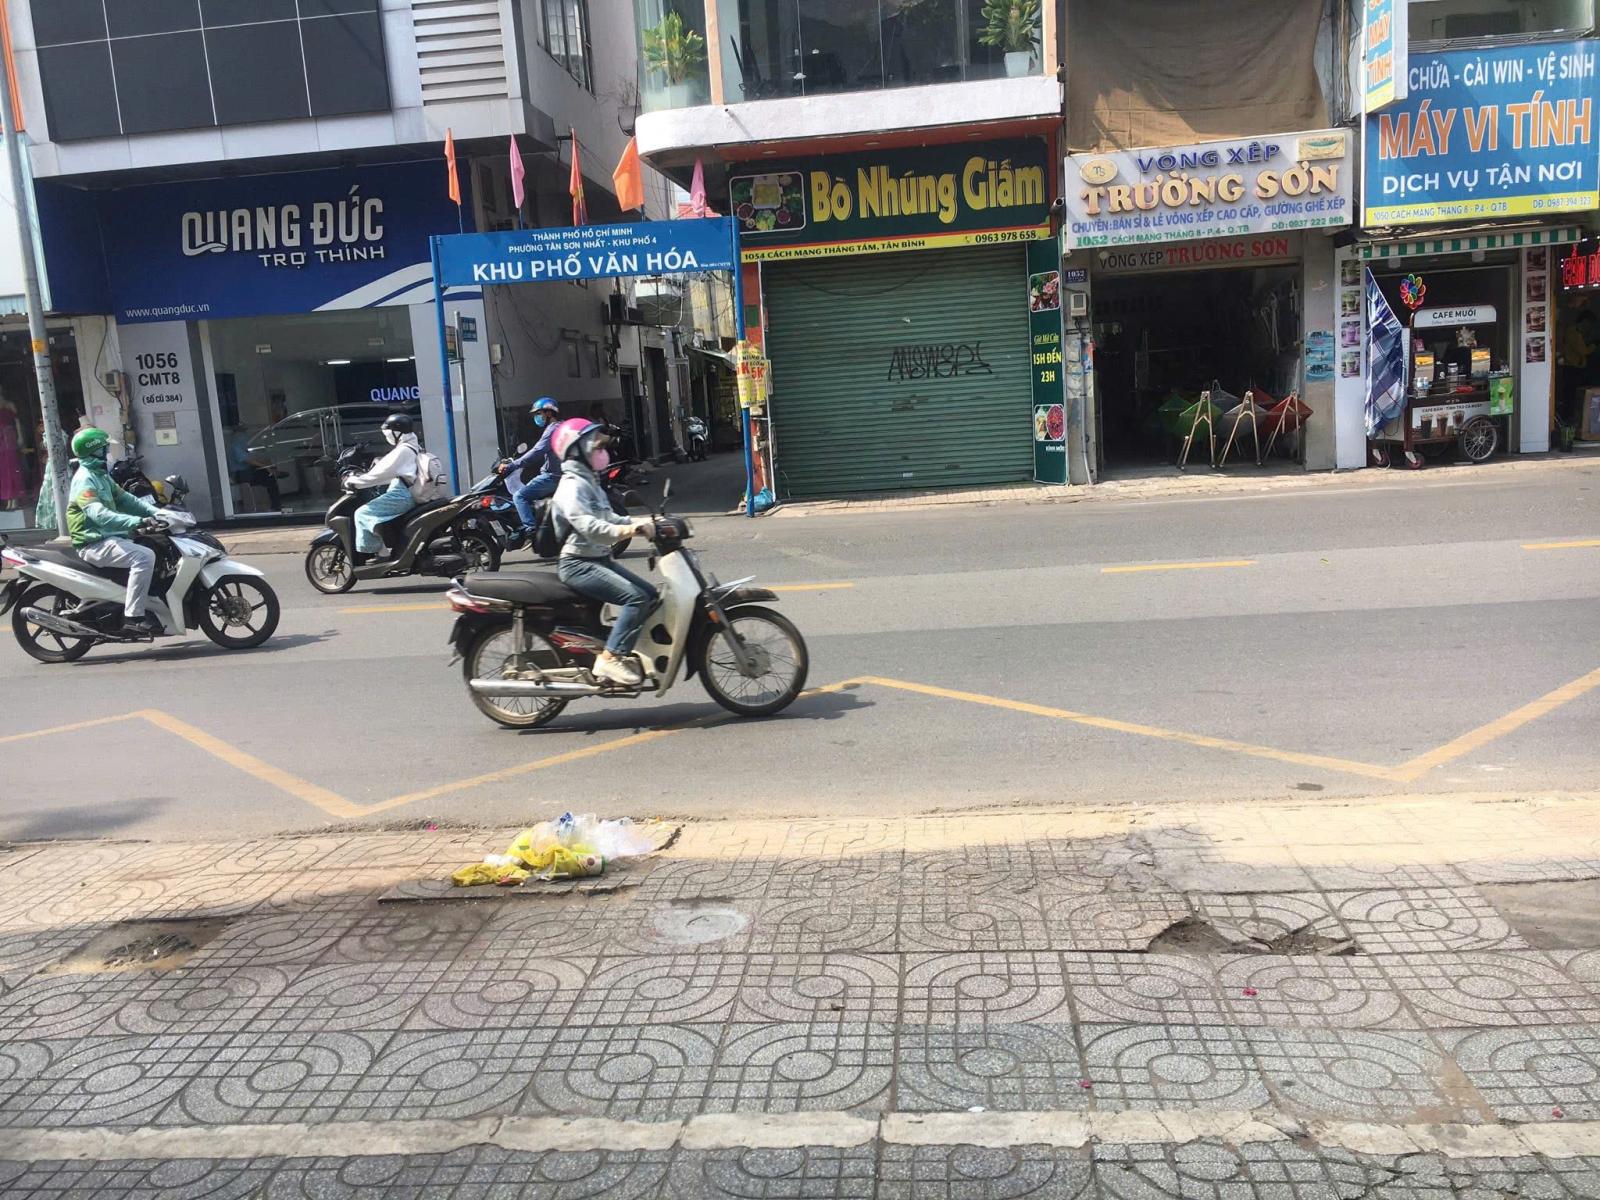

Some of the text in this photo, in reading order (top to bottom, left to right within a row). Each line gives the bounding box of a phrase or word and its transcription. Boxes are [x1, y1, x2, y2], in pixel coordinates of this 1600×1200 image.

[1409, 60, 1450, 91] CHỮA
[1463, 57, 1488, 86] CÀI
[1492, 58, 1523, 84] WIN
[1537, 51, 1556, 86] VỆ
[1560, 53, 1594, 80] SINH
[1378, 90, 1592, 160] MÁY VI TÍNH
[1080, 160, 1340, 216] TRƯỜNG SƠN
[1383, 160, 1582, 197] DỊCH VỤ TẬN NƠI
[810, 156, 1046, 224] Bò Nhúng Giấm
[1216, 208, 1238, 220] CAO
[1264, 200, 1303, 217] GIƯỜNG
[1327, 195, 1345, 210] XẾP
[182, 184, 384, 256] QUANG ĐỨC
[532, 230, 561, 241] THÀNH
[562, 229, 580, 240] PHỐ
[595, 226, 610, 237] CHÍ
[611, 227, 633, 237] MINH
[975, 230, 1037, 244] 0963 978 658
[1076, 234, 1108, 247] 1052
[1111, 232, 1135, 244] CÁCH
[1164, 229, 1195, 240] THÁNG
[508, 243, 543, 254] PHƯỜNG
[545, 241, 562, 251] TÂN
[563, 241, 581, 251] SƠN
[583, 238, 606, 249] NHẤT
[612, 238, 631, 247] KHU
[633, 235, 651, 246] PHỐ
[652, 236, 657, 244] 4
[767, 249, 792, 259] CÁCH
[794, 248, 823, 258] MẠNG
[824, 245, 855, 257] THÁNG
[882, 241, 900, 252] TÂN
[901, 239, 926, 251] BÌNH
[1167, 241, 1246, 265] TRƯỜNG
[1251, 236, 1289, 257] SƠN
[258, 243, 385, 269] TRỢ THÍNH
[473, 246, 698, 283] KHU PHỐ VĂN HÓA
[125, 303, 210, 318] www.quangduc.vn
[1432, 311, 1453, 319] CAFE
[135, 352, 178, 370] 1056
[1033, 346, 1062, 365] 15H ĐẾN
[138, 372, 181, 387] CMT8
[1040, 370, 1055, 383] 23H
[370, 386, 420, 402] QUANG
